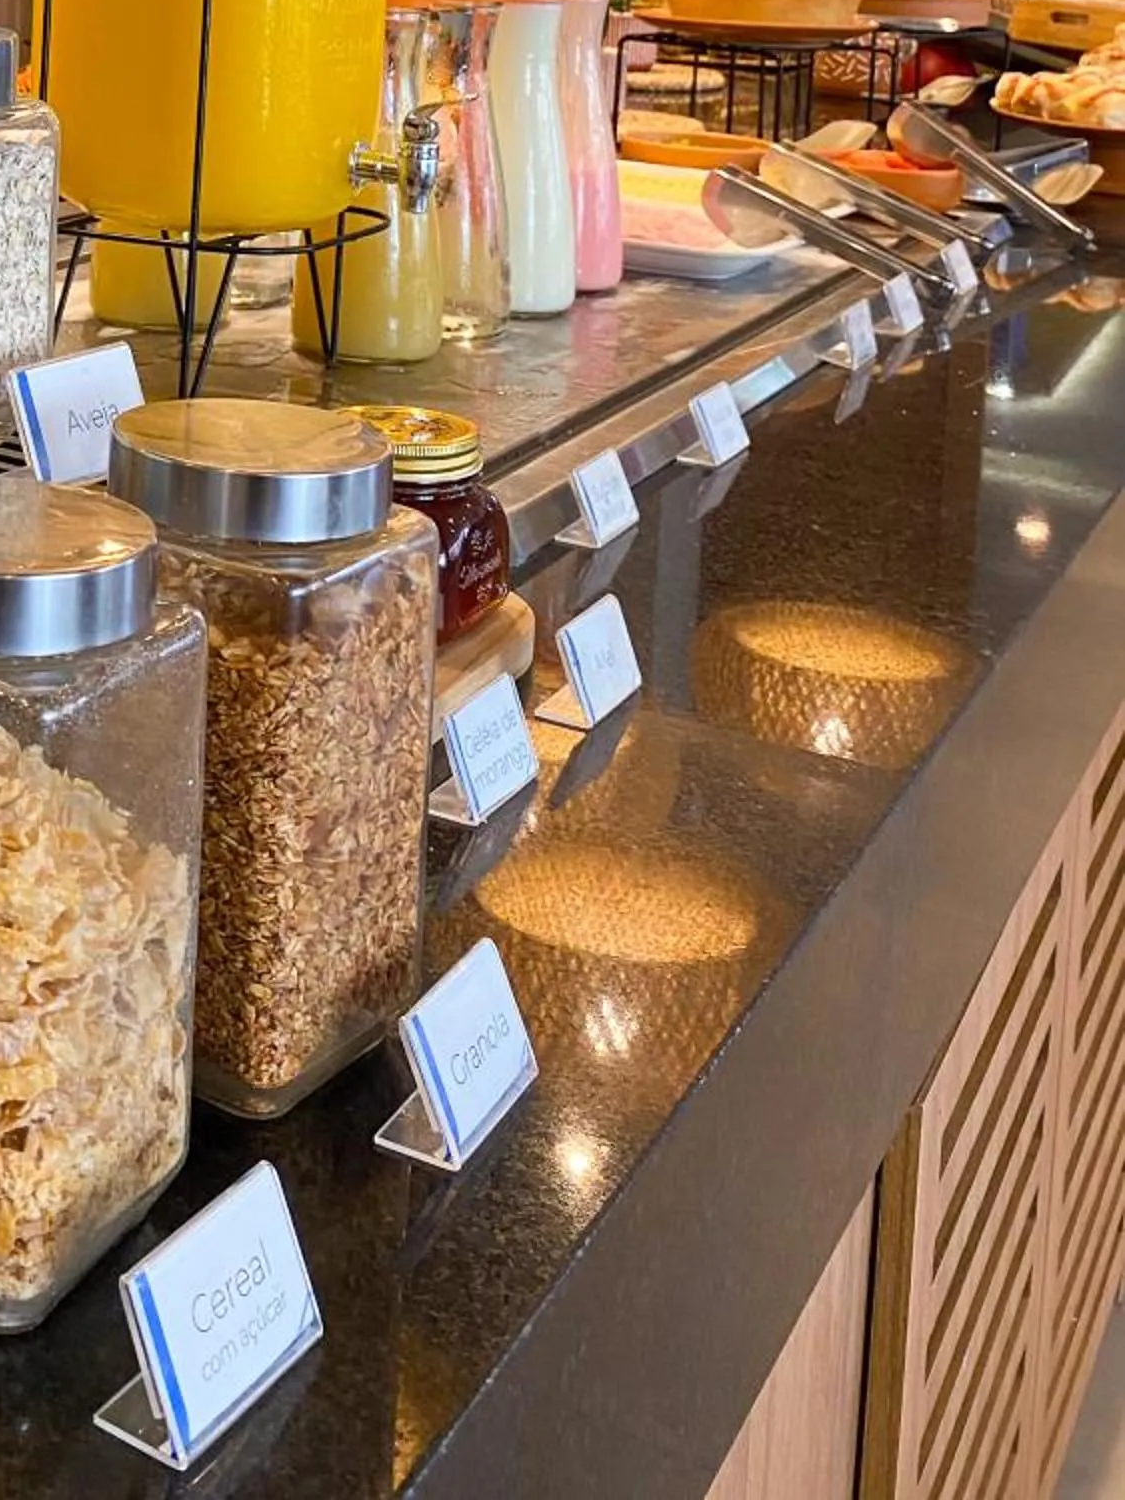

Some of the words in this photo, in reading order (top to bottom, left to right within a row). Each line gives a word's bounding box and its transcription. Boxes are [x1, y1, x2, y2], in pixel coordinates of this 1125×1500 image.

[501, 707, 518, 732] de
[475, 741, 528, 792] morango
[449, 1011, 511, 1085] Granola
[190, 1233, 273, 1334] Cereal
[201, 1339, 239, 1382] com
[239, 1289, 287, 1347] açúcar
